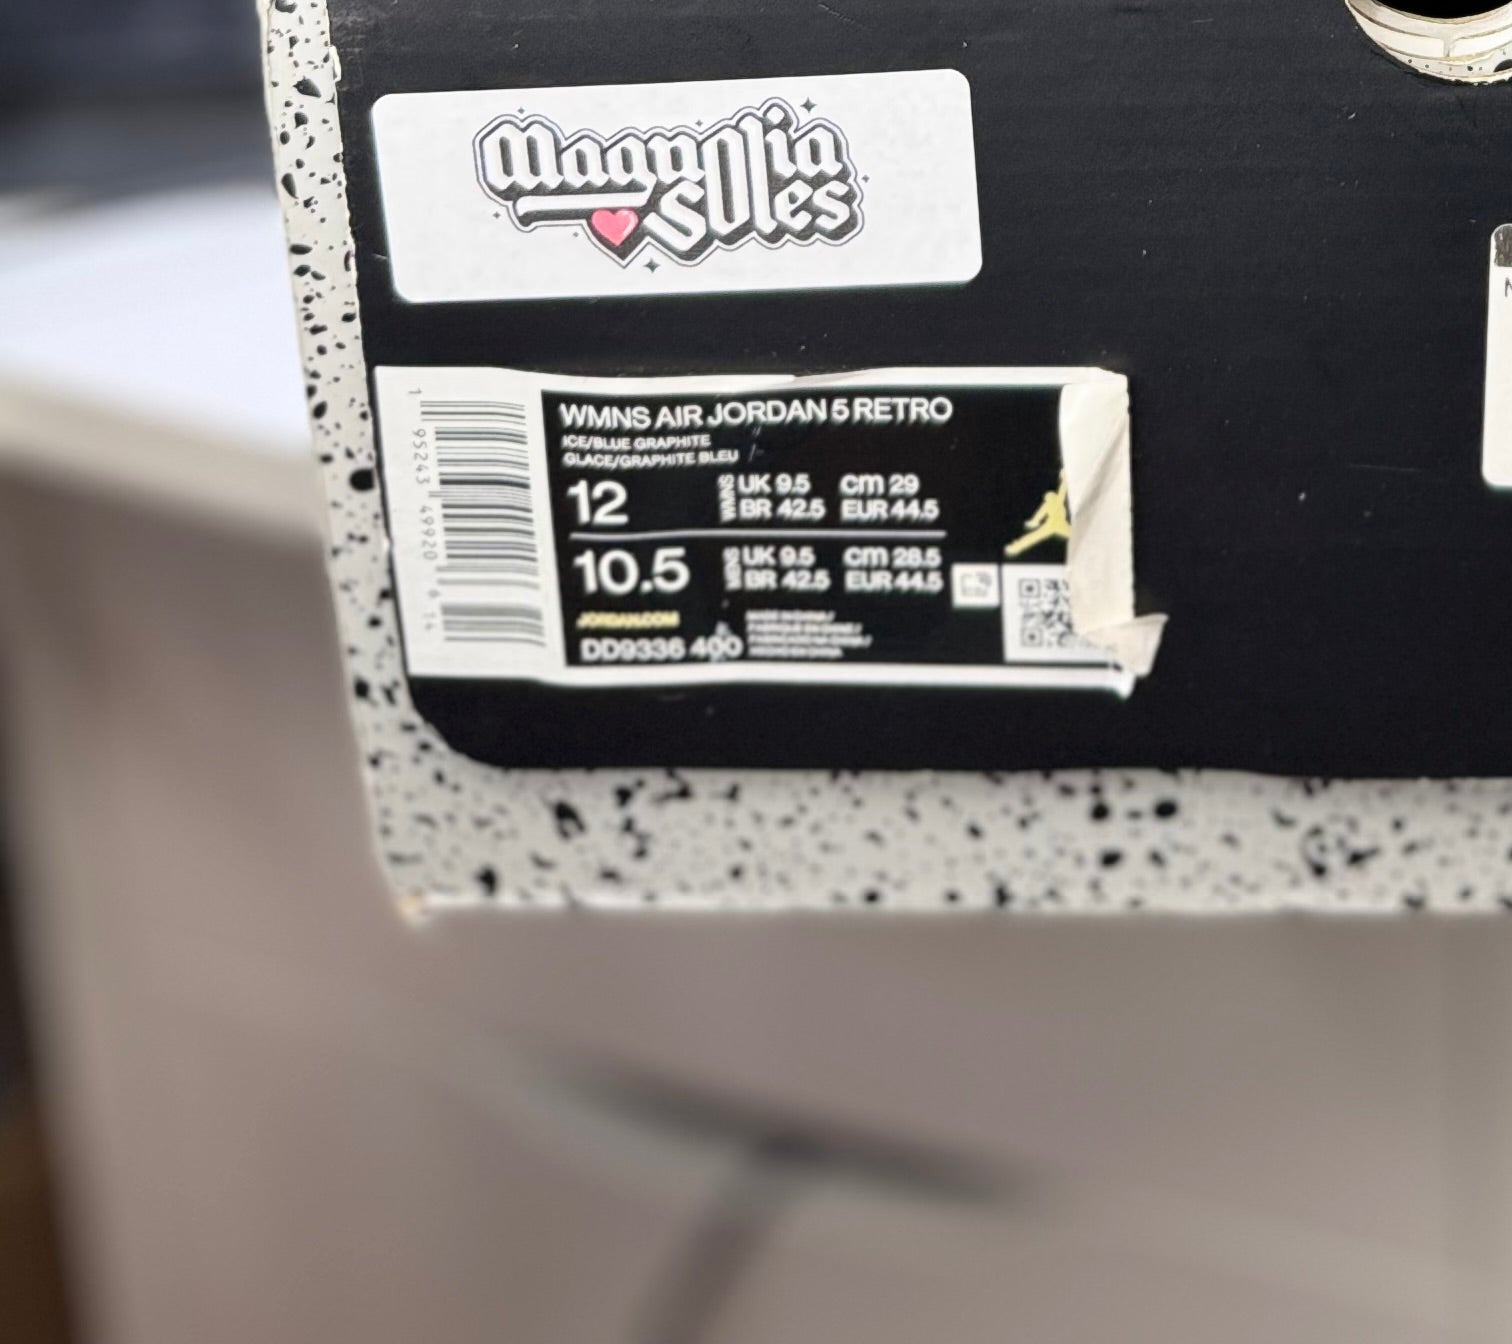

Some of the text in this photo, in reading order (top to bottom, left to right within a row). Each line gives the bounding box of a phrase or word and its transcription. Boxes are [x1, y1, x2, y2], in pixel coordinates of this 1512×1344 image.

[559, 396, 953, 430] WMNS AIR JORDAN 5 RETRO
[562, 432, 711, 450] ICE/BLUE GRAPHITE
[411, 428, 432, 486] 95243
[563, 448, 739, 469] GLACE/GRAPHITE BLEU
[738, 473, 771, 495] UK
[775, 473, 811, 495] 9.5
[888, 473, 920, 497] 29
[566, 479, 629, 526] 12
[738, 498, 940, 522] BR 42.5 EUR 44.5
[742, 546, 776, 567] UK
[779, 546, 816, 567] 9.5
[892, 546, 942, 567] 28.5
[573, 547, 691, 595] 10.5
[743, 569, 944, 592] BR 42.5 EUR 44.5
